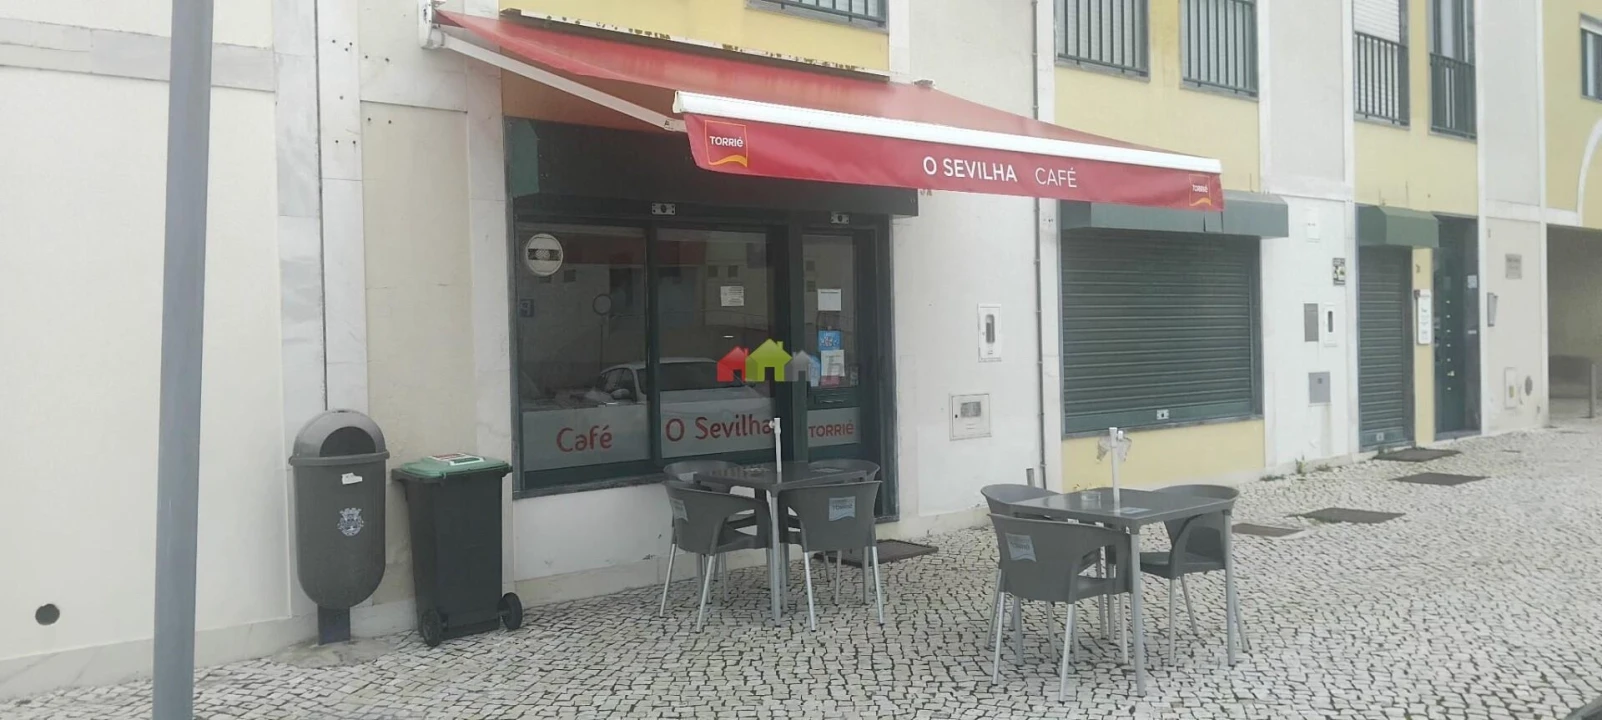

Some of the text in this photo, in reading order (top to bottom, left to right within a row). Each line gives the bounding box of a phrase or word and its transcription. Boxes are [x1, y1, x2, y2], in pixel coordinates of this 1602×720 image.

[922, 156, 1078, 188] O SEVILHA CAFÉ
[556, 425, 613, 452] Café
[665, 414, 772, 442] O Sevilha
